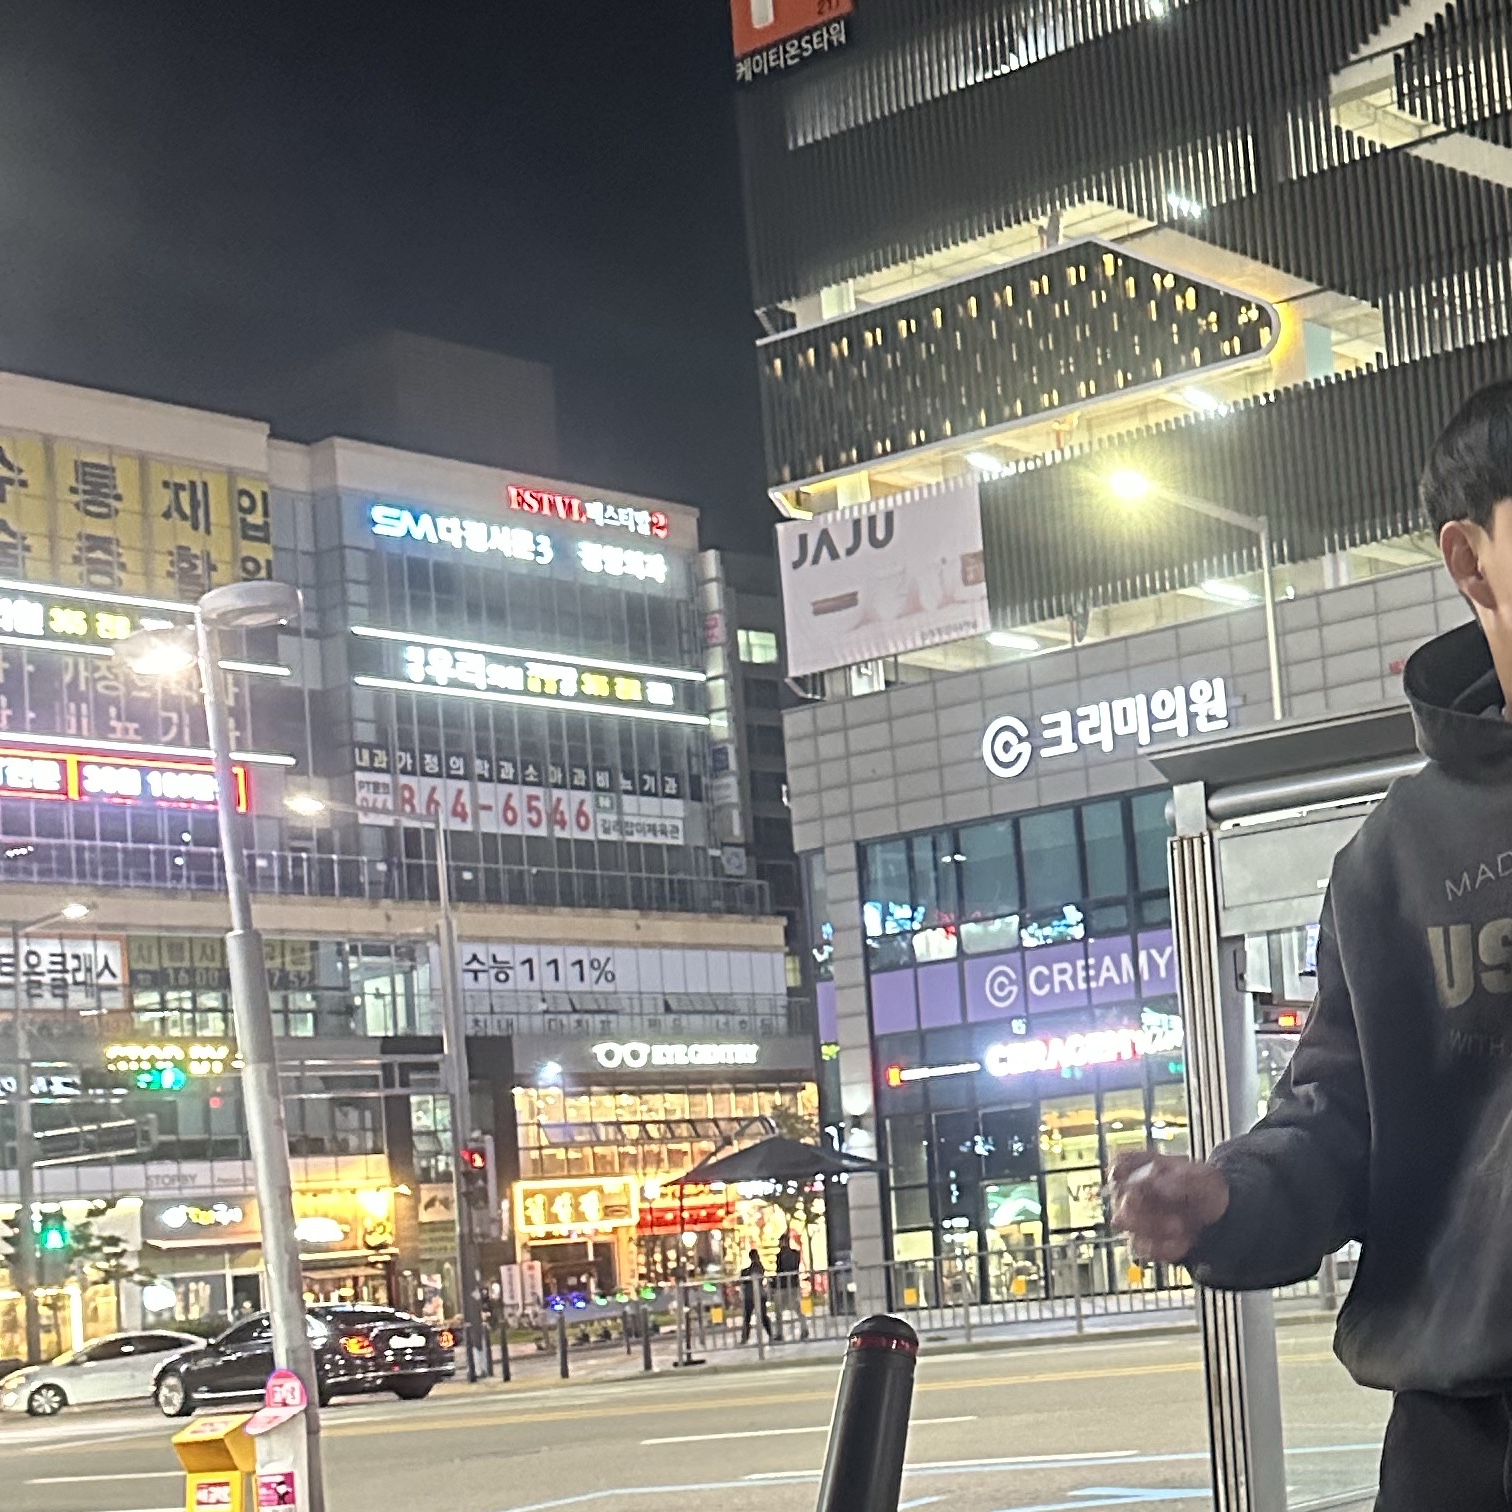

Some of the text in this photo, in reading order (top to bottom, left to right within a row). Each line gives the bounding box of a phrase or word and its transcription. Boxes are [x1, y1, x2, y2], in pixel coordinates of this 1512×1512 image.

[792, 511, 895, 570] JAJU
[1039, 677, 1230, 759] 크리미의원
[399, 783, 592, 832] 864-6546
[463, 953, 616, 984] 수능111%
[1029, 944, 1174, 997] CREAMY
